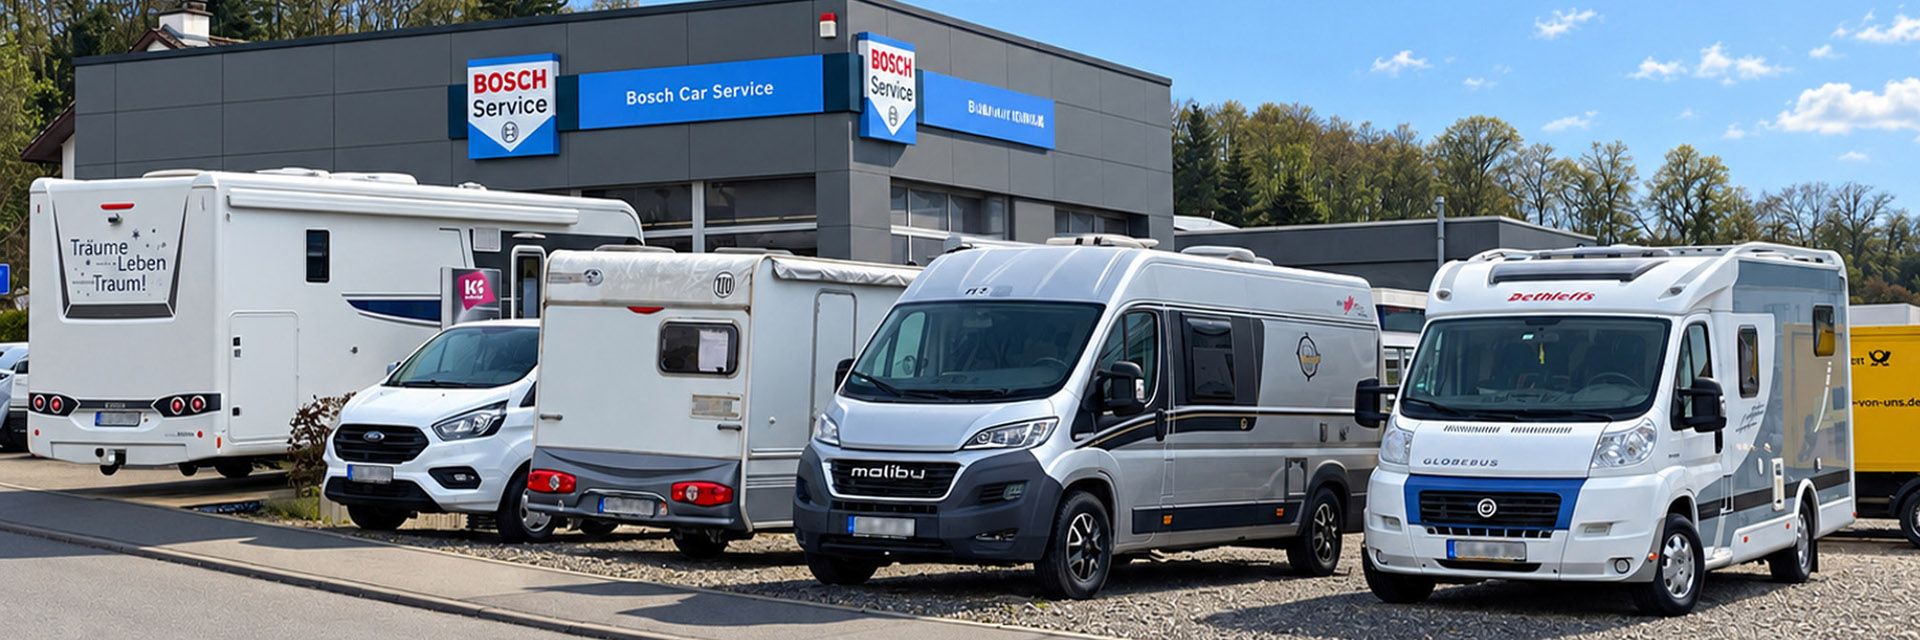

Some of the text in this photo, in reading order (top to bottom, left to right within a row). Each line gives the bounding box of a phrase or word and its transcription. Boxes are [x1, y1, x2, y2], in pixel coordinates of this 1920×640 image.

[870, 48, 912, 78] BOSCH
[474, 69, 546, 94] BOSCH
[871, 75, 913, 102] Service
[626, 81, 774, 106] Bosch Car Service
[473, 95, 547, 118] Service
[71, 238, 128, 256] Träume
[118, 254, 166, 272] Leben
[93, 274, 146, 292] Traum!
[851, 464, 925, 479] malibu
[1423, 457, 1498, 467] GLOBEBUS
